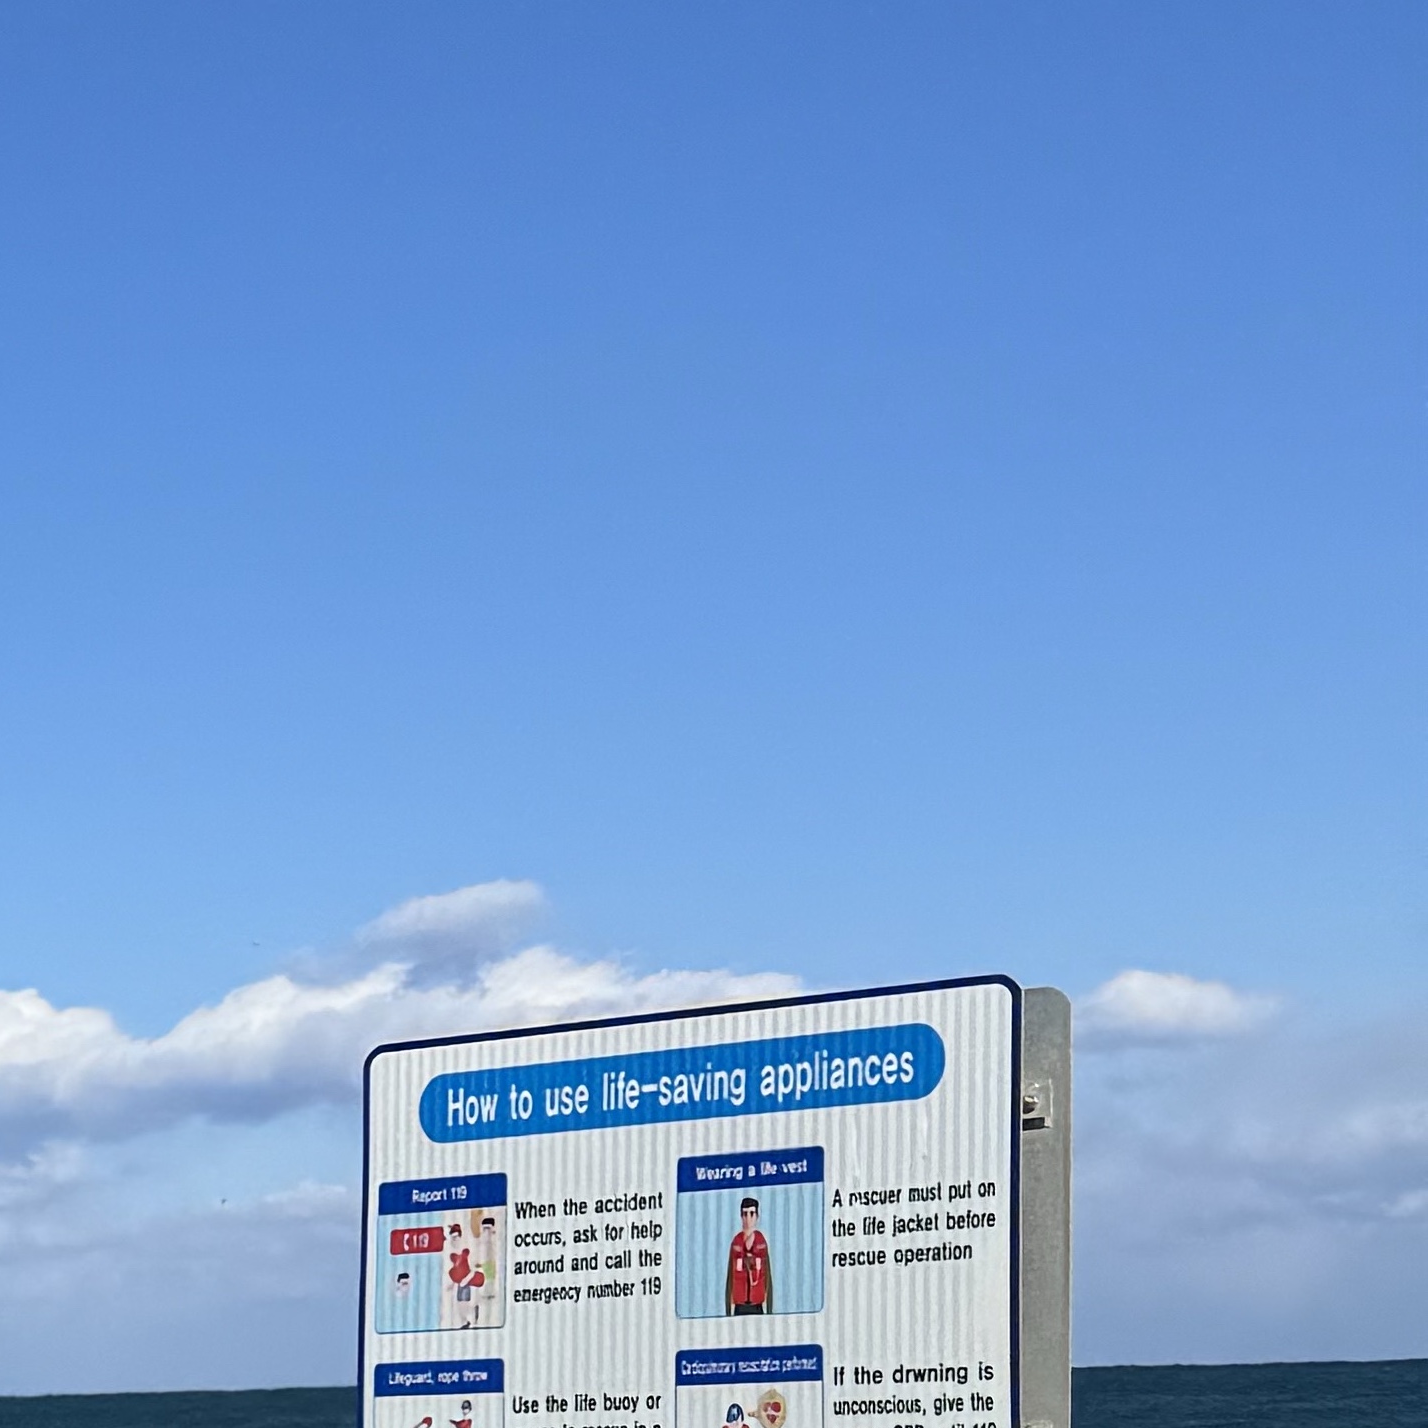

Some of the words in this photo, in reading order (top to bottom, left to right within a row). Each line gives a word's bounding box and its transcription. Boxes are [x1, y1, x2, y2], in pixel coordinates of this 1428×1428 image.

[448, 1088, 498, 1126] How
[510, 1084, 533, 1120] to
[546, 1084, 589, 1117] use
[602, 1062, 746, 1111] life-saving
[760, 1050, 914, 1103] appliances
[748, 1165, 755, 1177] a
[782, 1159, 807, 1173] vest
[412, 1189, 447, 1205] Report
[451, 1185, 467, 1199] 119
[515, 1201, 555, 1219] When
[563, 1198, 587, 1216] the
[595, 1192, 663, 1213] accident
[832, 1188, 842, 1207] A
[908, 1181, 941, 1202] must
[949, 1180, 971, 1202] put
[978, 1182, 995, 1198] on
[514, 1230, 566, 1247] occurs,
[573, 1224, 598, 1243] ask
[605, 1223, 624, 1241] for
[631, 1220, 663, 1241] help
[832, 1219, 855, 1237] the
[863, 1216, 885, 1235] life
[892, 1213, 939, 1237] jacket
[946, 1210, 996, 1230] before
[514, 1254, 564, 1275] around
[571, 1252, 598, 1271] and
[605, 1250, 631, 1269] call
[638, 1249, 662, 1267] the
[832, 1250, 886, 1267] rescue
[894, 1242, 972, 1266] operation
[587, 1279, 634, 1298] number
[640, 1277, 661, 1295] 119
[834, 1366, 844, 1386] If
[854, 1366, 883, 1385] the
[892, 1363, 968, 1384] drwning
[978, 1361, 994, 1380] is
[512, 1395, 539, 1413] Use
[546, 1395, 568, 1412] the
[575, 1394, 596, 1411] life
[603, 1392, 639, 1413] buoy
[646, 1395, 661, 1410] or
[833, 1395, 927, 1416] unconscious,
[933, 1393, 964, 1416] give
[971, 1392, 993, 1411] the
